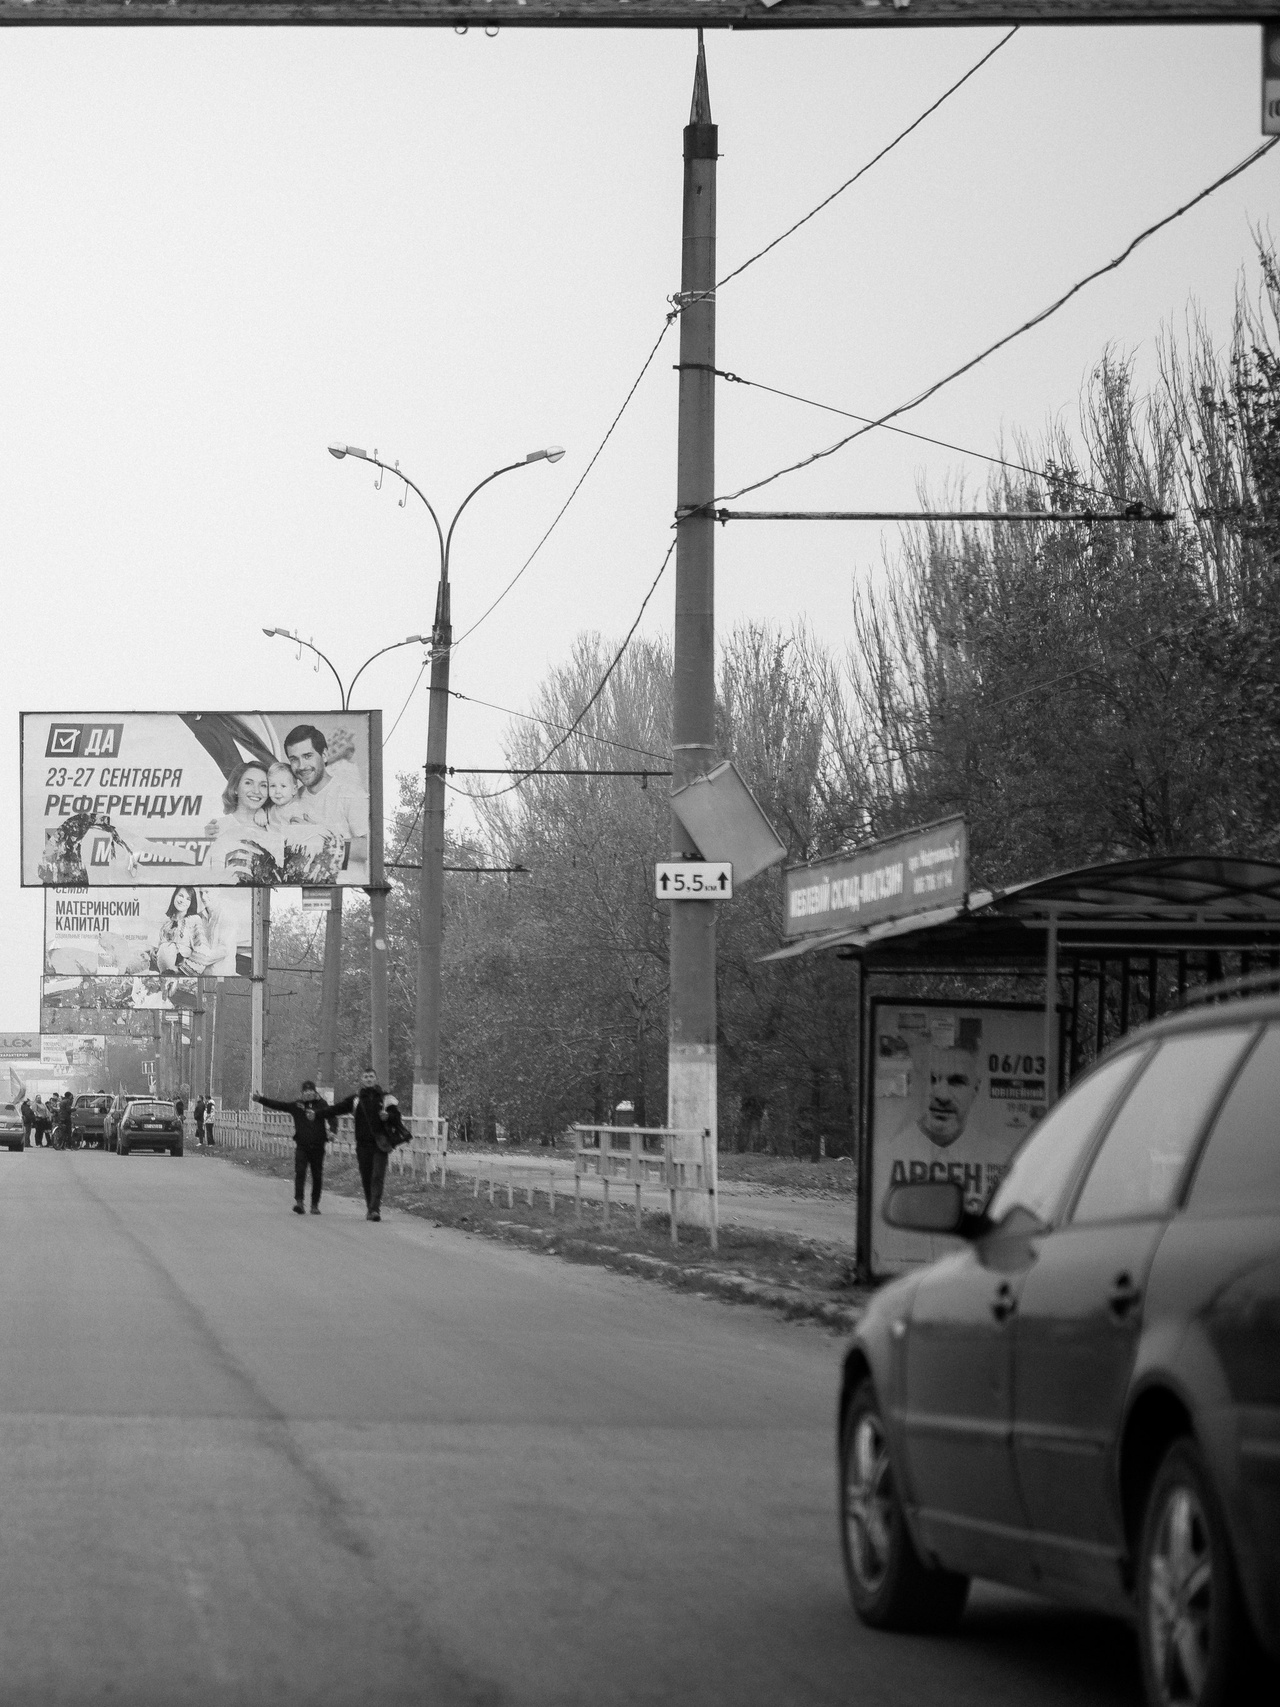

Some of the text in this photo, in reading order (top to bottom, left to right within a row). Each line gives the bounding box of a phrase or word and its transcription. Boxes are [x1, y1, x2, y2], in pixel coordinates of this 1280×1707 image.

[84, 729, 115, 756] ДА
[45, 767, 183, 787] 23-27 СЕНТЯБРЯ
[44, 794, 203, 819] РЕФЕРЕНДУМ
[55, 899, 140, 917] МАТЕРИНСКИЙ
[55, 917, 110, 932] КАПИТАЛ
[989, 1053, 1045, 1075] 06/03
